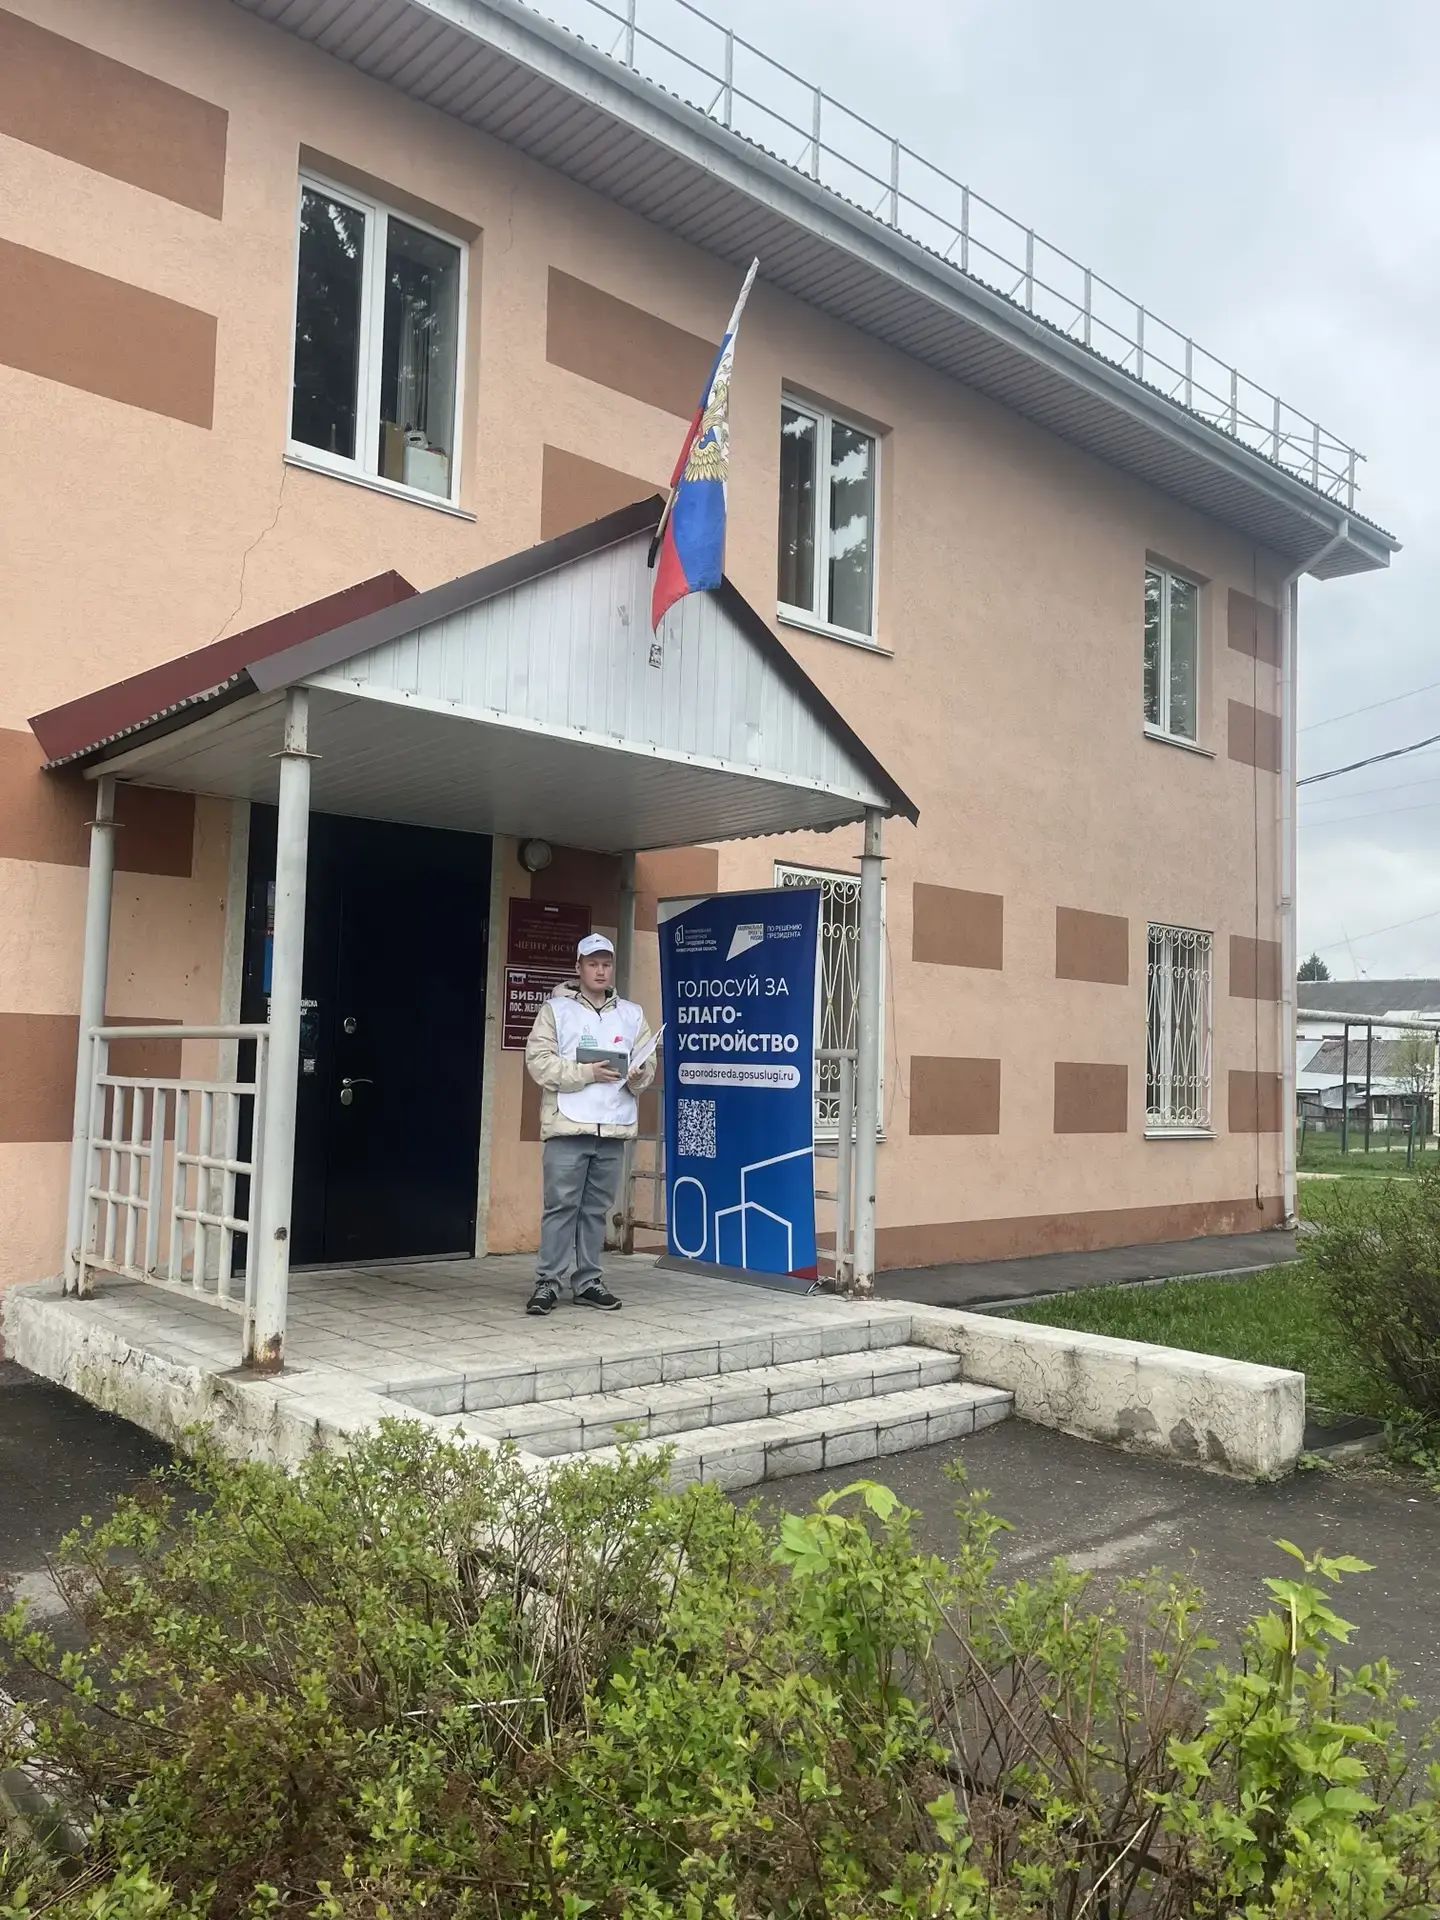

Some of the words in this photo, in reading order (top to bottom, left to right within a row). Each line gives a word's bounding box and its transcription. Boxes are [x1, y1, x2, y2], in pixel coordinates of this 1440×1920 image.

[775, 924, 802, 932] РЕШЕНИЮ
[766, 931, 801, 940] ПРЕЗИДЕНТА
[677, 974, 759, 998] ГОЛОСУЙ
[764, 977, 790, 996] ЗА
[510, 990, 551, 1002] БИБЛИ
[509, 1002, 524, 1012] ПОС.
[678, 1005, 743, 1024] БЛАГО-
[678, 1029, 799, 1053] УСТРОЙСТВО
[680, 1068, 794, 1082] zagorodsreda.gosuslugi.ru
